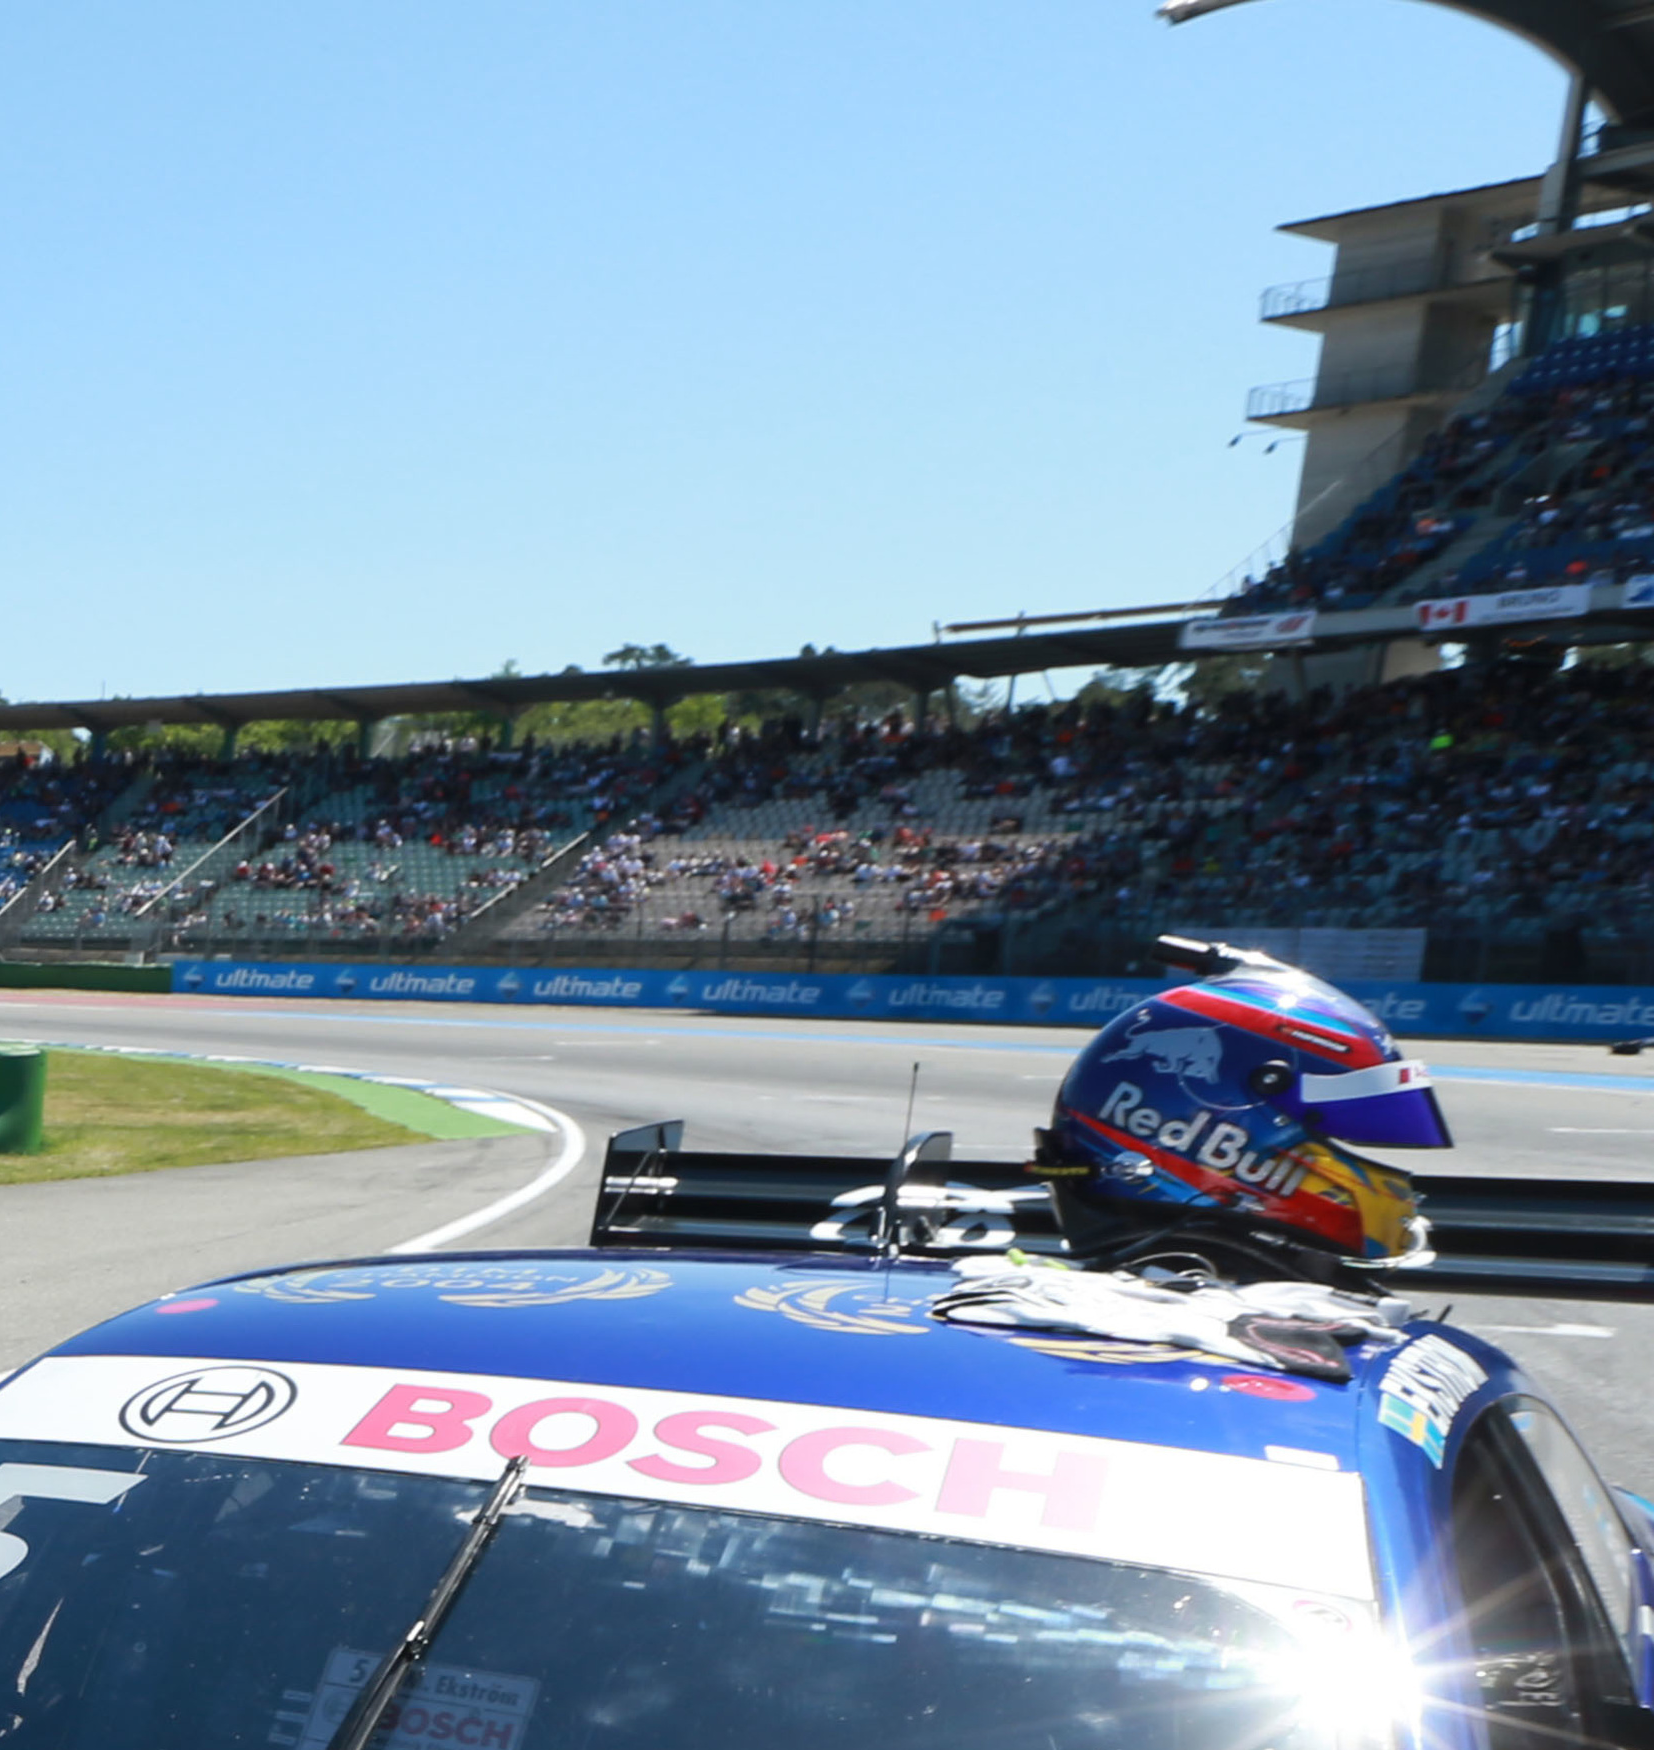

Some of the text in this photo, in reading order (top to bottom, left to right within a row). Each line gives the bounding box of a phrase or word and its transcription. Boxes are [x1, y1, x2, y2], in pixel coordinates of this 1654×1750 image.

[216, 970, 314, 990] ultimate
[369, 973, 475, 995] ultimate
[534, 976, 642, 999] ultimate
[702, 980, 820, 1004] ultimate
[1099, 1081, 1309, 1198] Red Bull
[339, 1384, 1113, 1534] BOSCH
